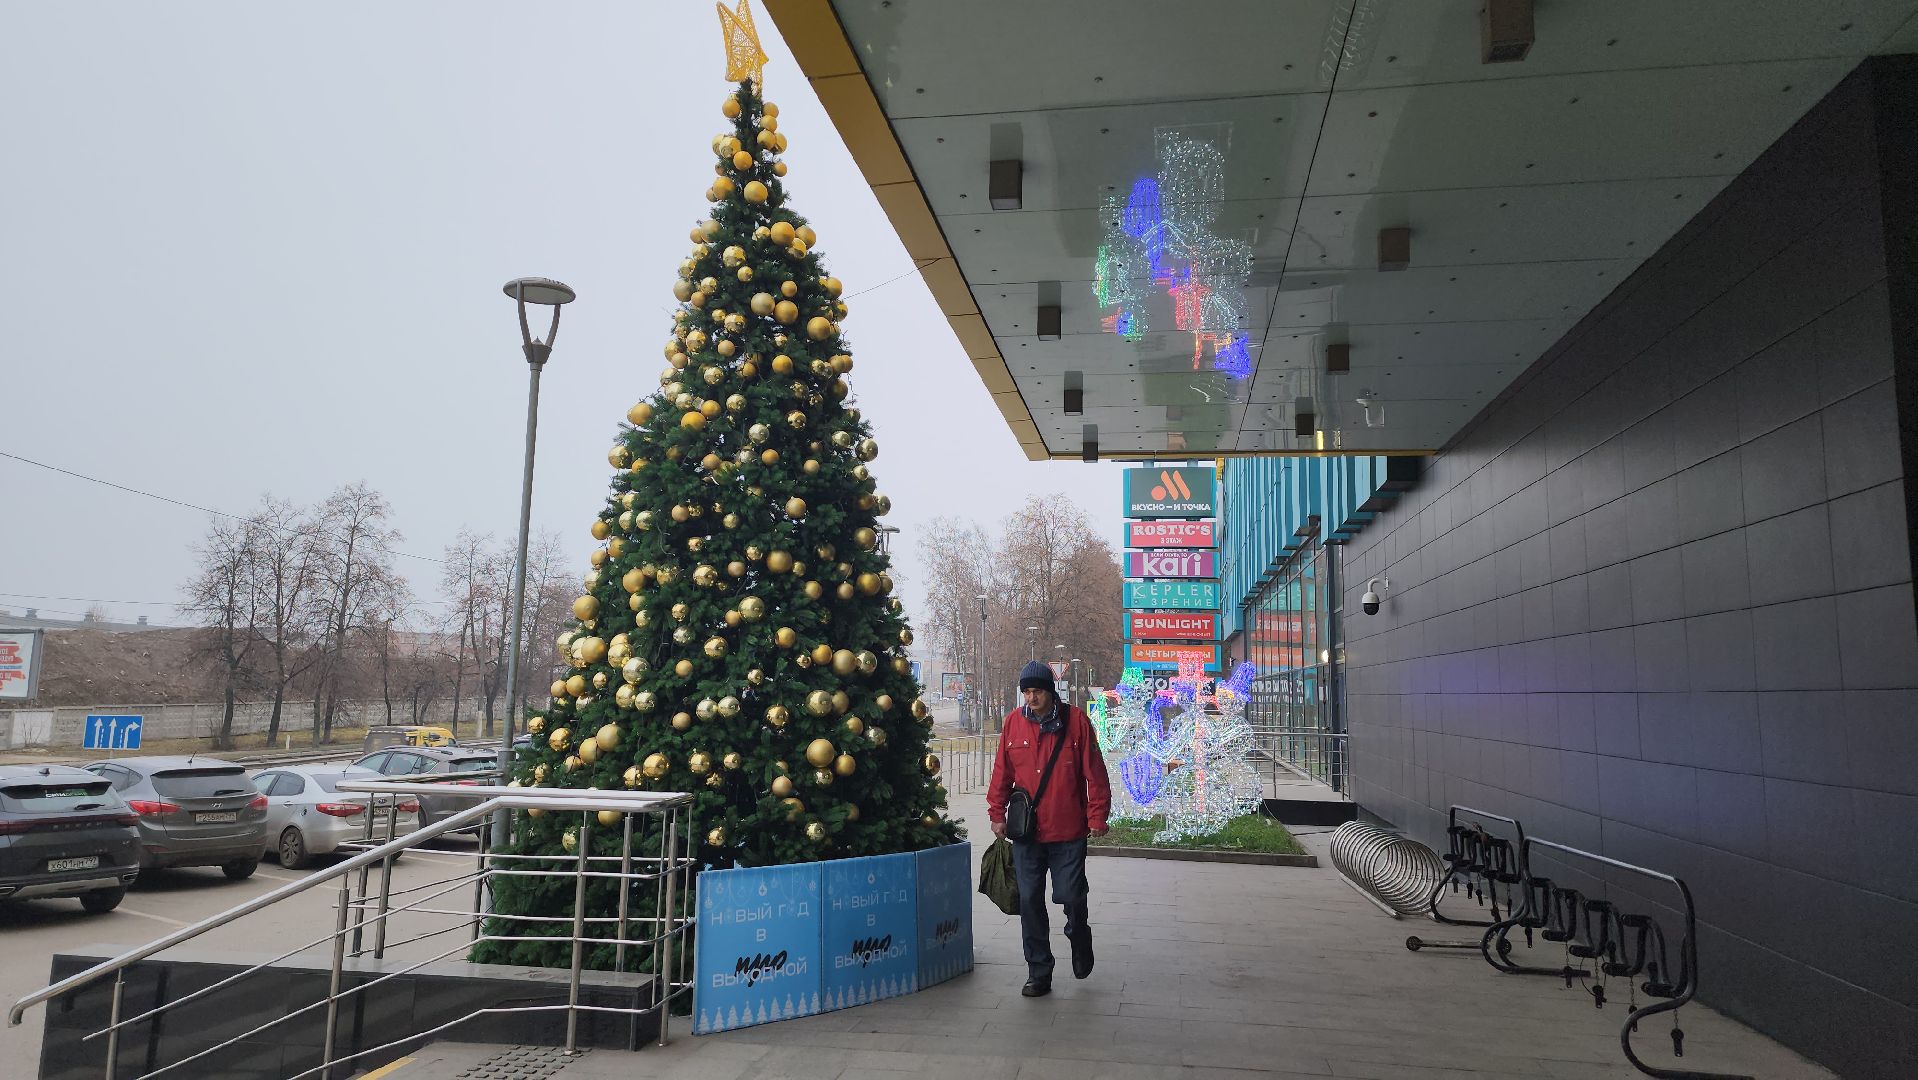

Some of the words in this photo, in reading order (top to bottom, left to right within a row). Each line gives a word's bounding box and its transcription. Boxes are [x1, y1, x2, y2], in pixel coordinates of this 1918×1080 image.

[1131, 503, 1165, 511] ВКУСНО
[1173, 503, 1180, 511] И
[1181, 503, 1211, 511] ТОЧКА
[1132, 524, 1211, 536] ROSTIC'S
[1142, 552, 1202, 576] kari
[1132, 584, 1213, 598] KEPLER
[1151, 598, 1212, 607] ЗРЕНИЕ
[1134, 618, 1211, 629] SUNLIGHT
[832, 889, 879, 911] НВЫЙ
[881, 889, 908, 904] ГД
[711, 902, 772, 926] НВЫЙ
[778, 901, 810, 917] ГД
[867, 913, 876, 927] В
[756, 928, 767, 942] В
[834, 940, 907, 969] ВЫХОДНОЙ
[712, 957, 807, 988] ВЫХОДНОЙ
